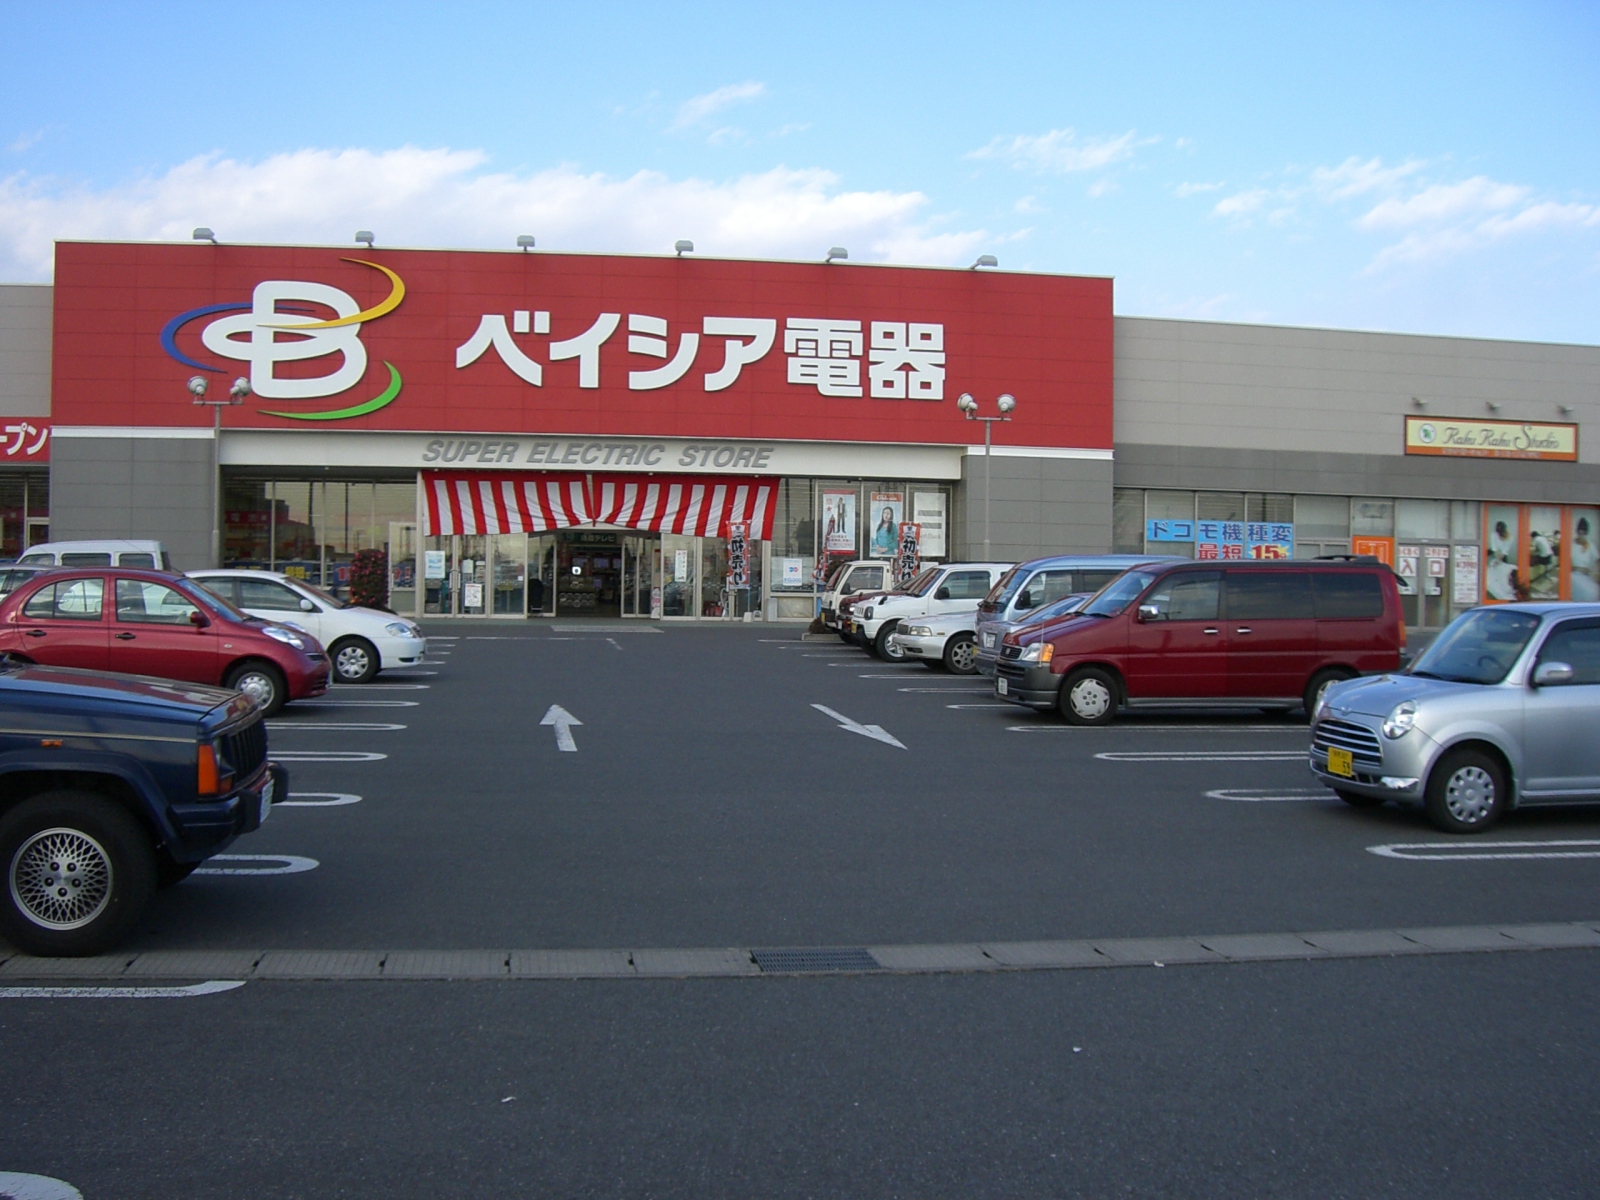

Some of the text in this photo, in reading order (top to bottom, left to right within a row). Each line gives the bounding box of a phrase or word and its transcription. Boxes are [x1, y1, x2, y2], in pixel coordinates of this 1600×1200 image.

[456, 310, 945, 401] ベイシア電器
[422, 438, 771, 468] SUPER ELECTRIC STORE
[1152, 521, 1292, 542] ドコモ機種変
